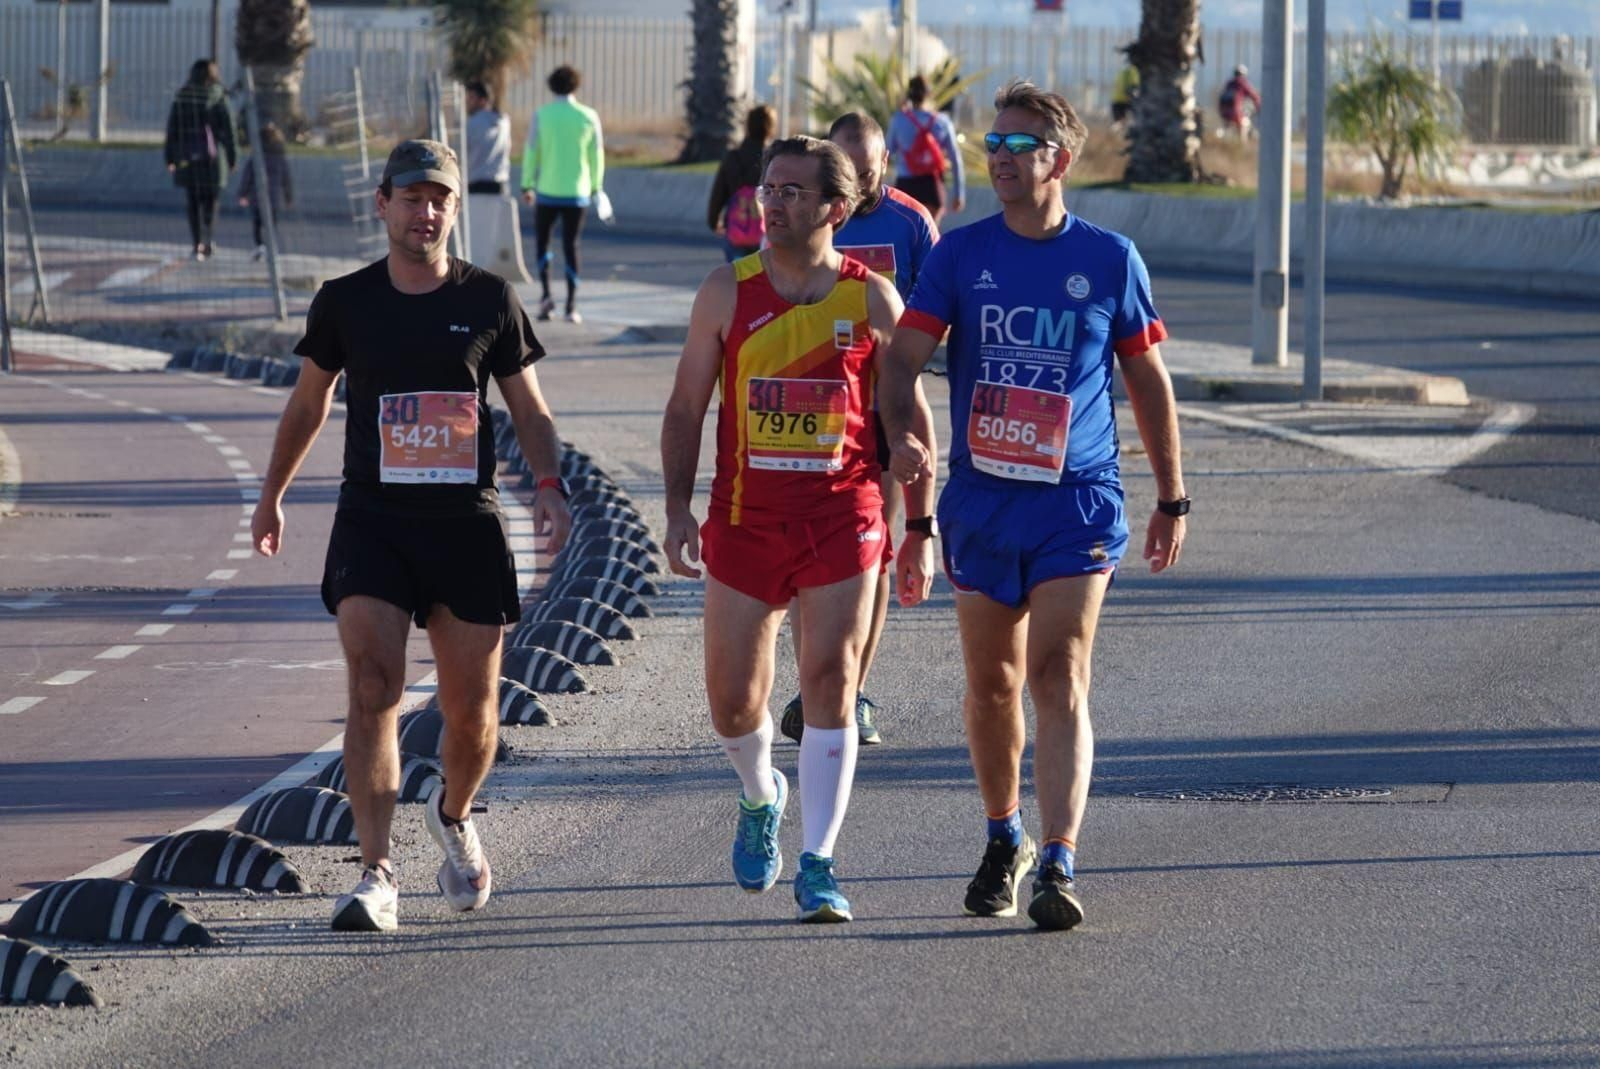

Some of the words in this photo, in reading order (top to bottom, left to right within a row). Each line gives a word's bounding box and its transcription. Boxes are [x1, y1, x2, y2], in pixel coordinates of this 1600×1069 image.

[981, 304, 1076, 350] RCM
[981, 361, 1067, 394] 1873
[382, 395, 418, 424] 30
[749, 379, 781, 412] 30
[973, 384, 1004, 416] 30
[391, 425, 451, 448] 5421
[756, 412, 817, 435] 7976
[976, 416, 1037, 445] 5056
